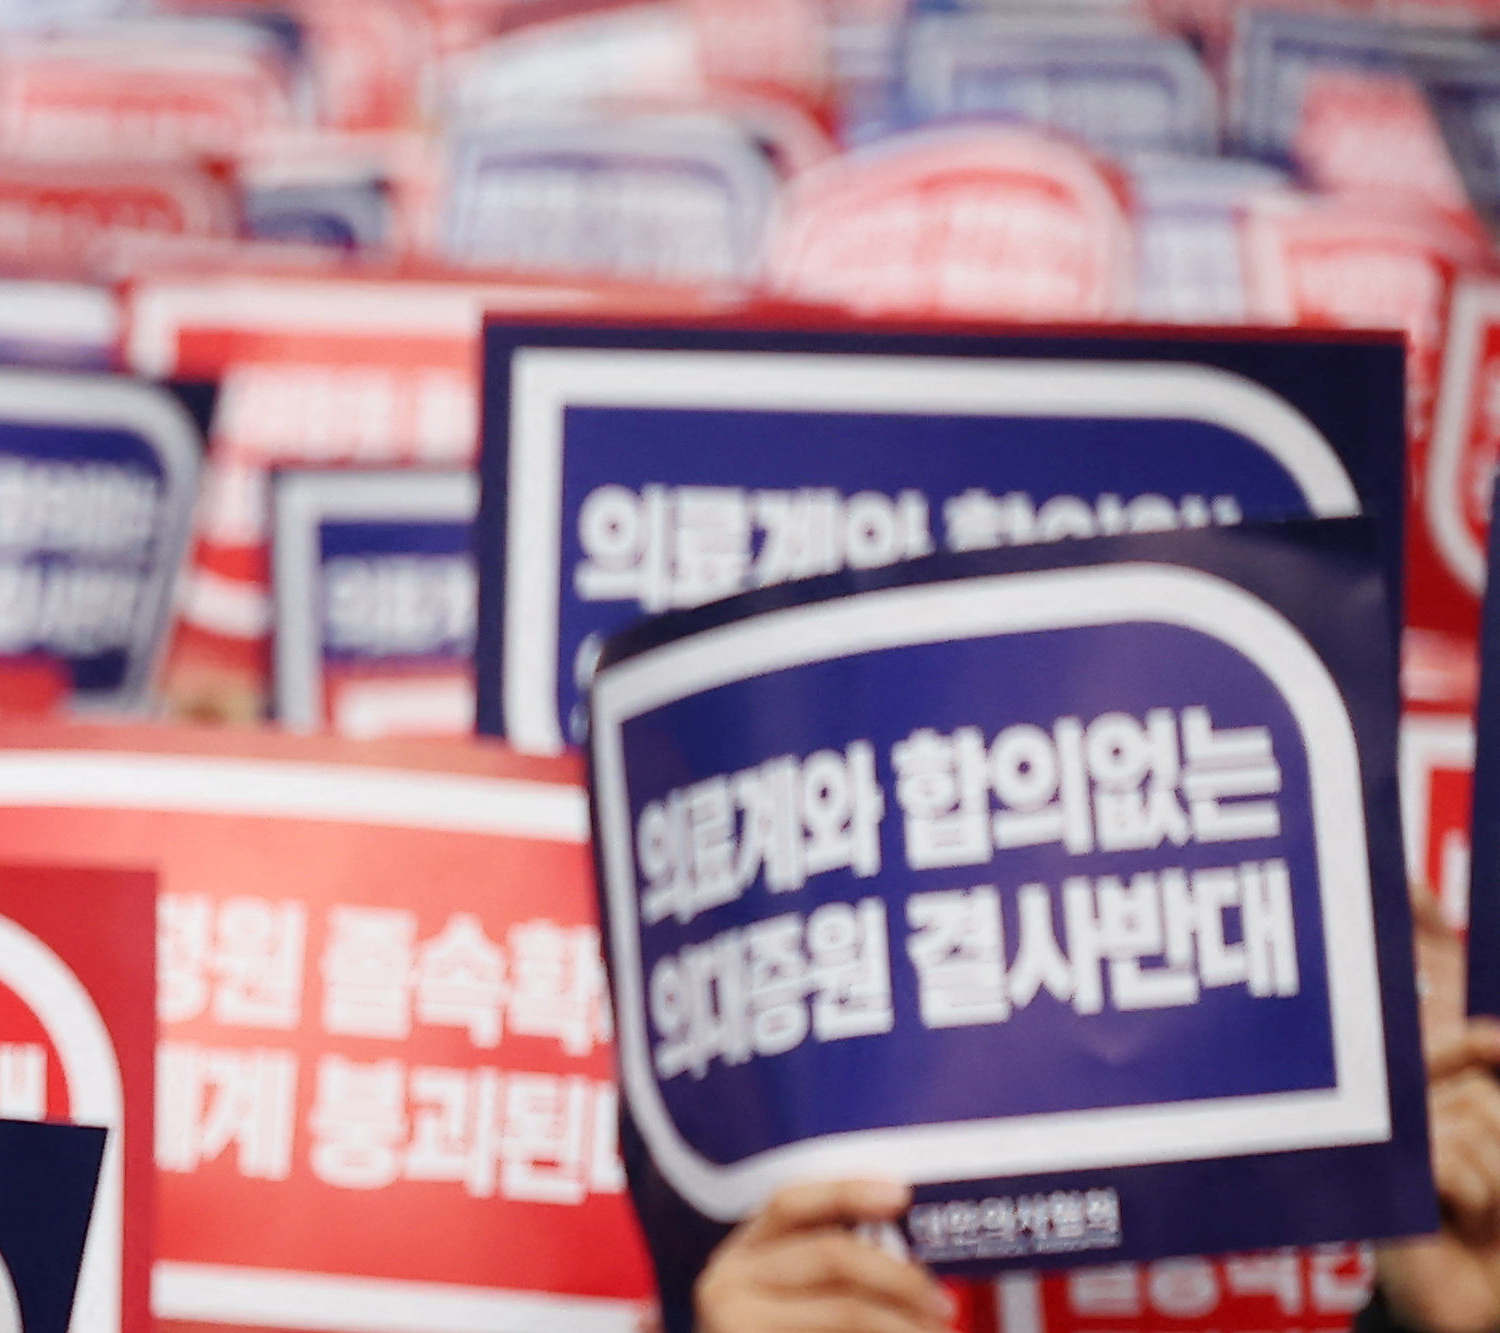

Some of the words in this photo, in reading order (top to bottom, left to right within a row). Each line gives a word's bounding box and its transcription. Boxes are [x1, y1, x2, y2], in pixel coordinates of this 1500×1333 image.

[640, 739, 884, 925] 의료계와
[892, 706, 1281, 872] 합의없는
[648, 895, 893, 1081] 의대증원
[908, 858, 1298, 1030] 결사반대
